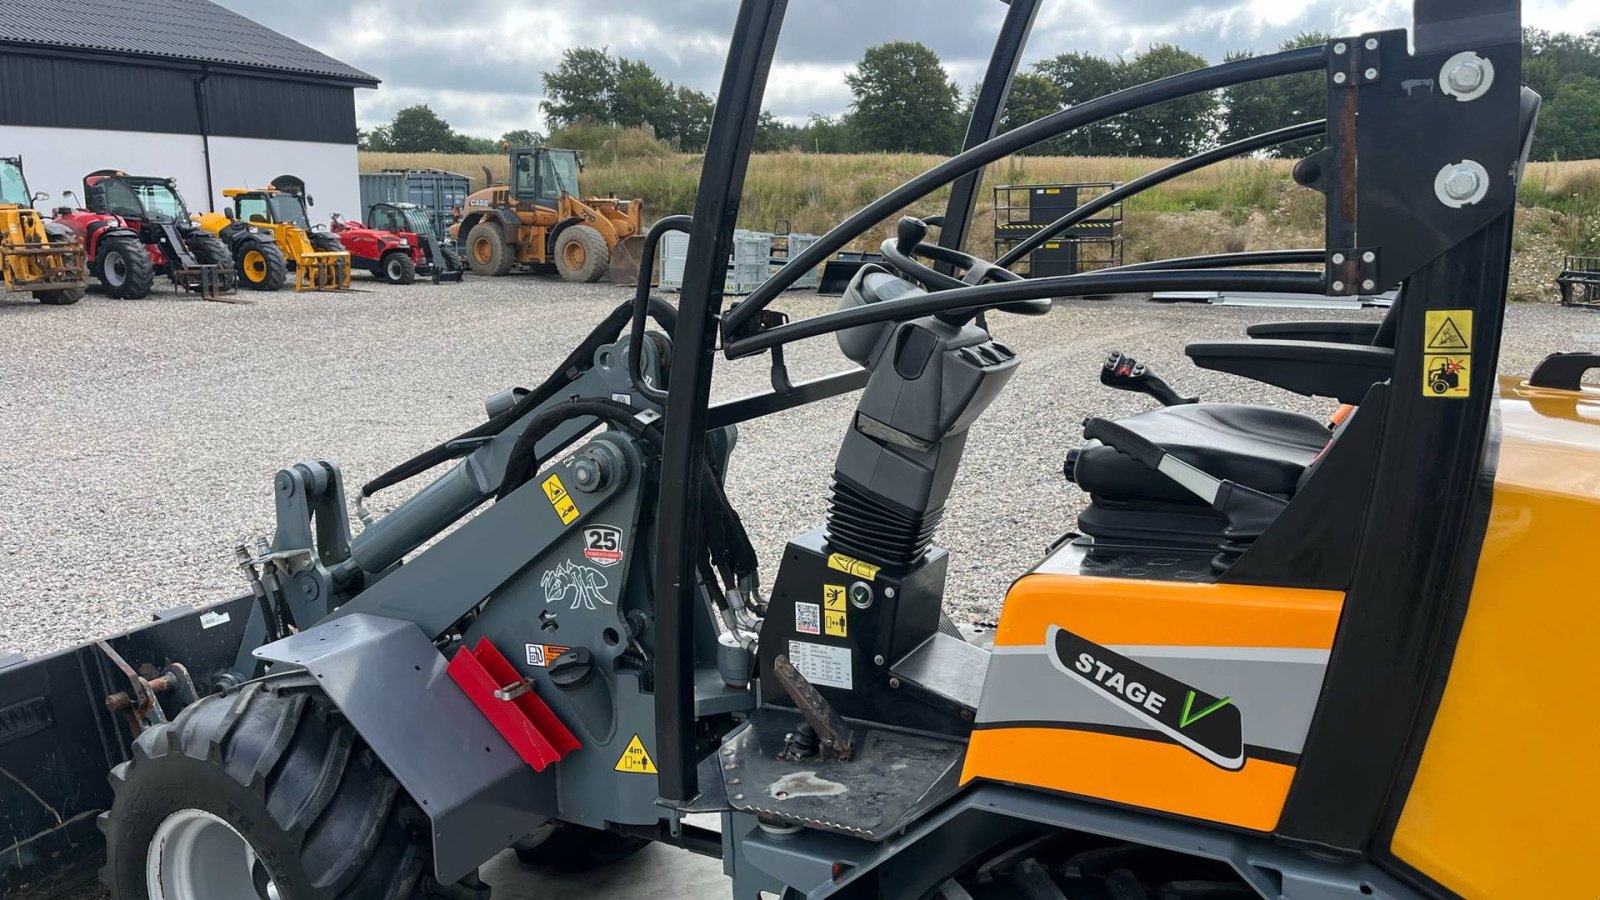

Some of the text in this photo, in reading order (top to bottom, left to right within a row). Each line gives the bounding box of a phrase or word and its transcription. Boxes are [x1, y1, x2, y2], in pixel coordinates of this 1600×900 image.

[470, 199, 489, 207] CASE
[589, 530, 617, 551] 25
[1075, 652, 1233, 729] STAGE V
[629, 746, 643, 755] 4m
